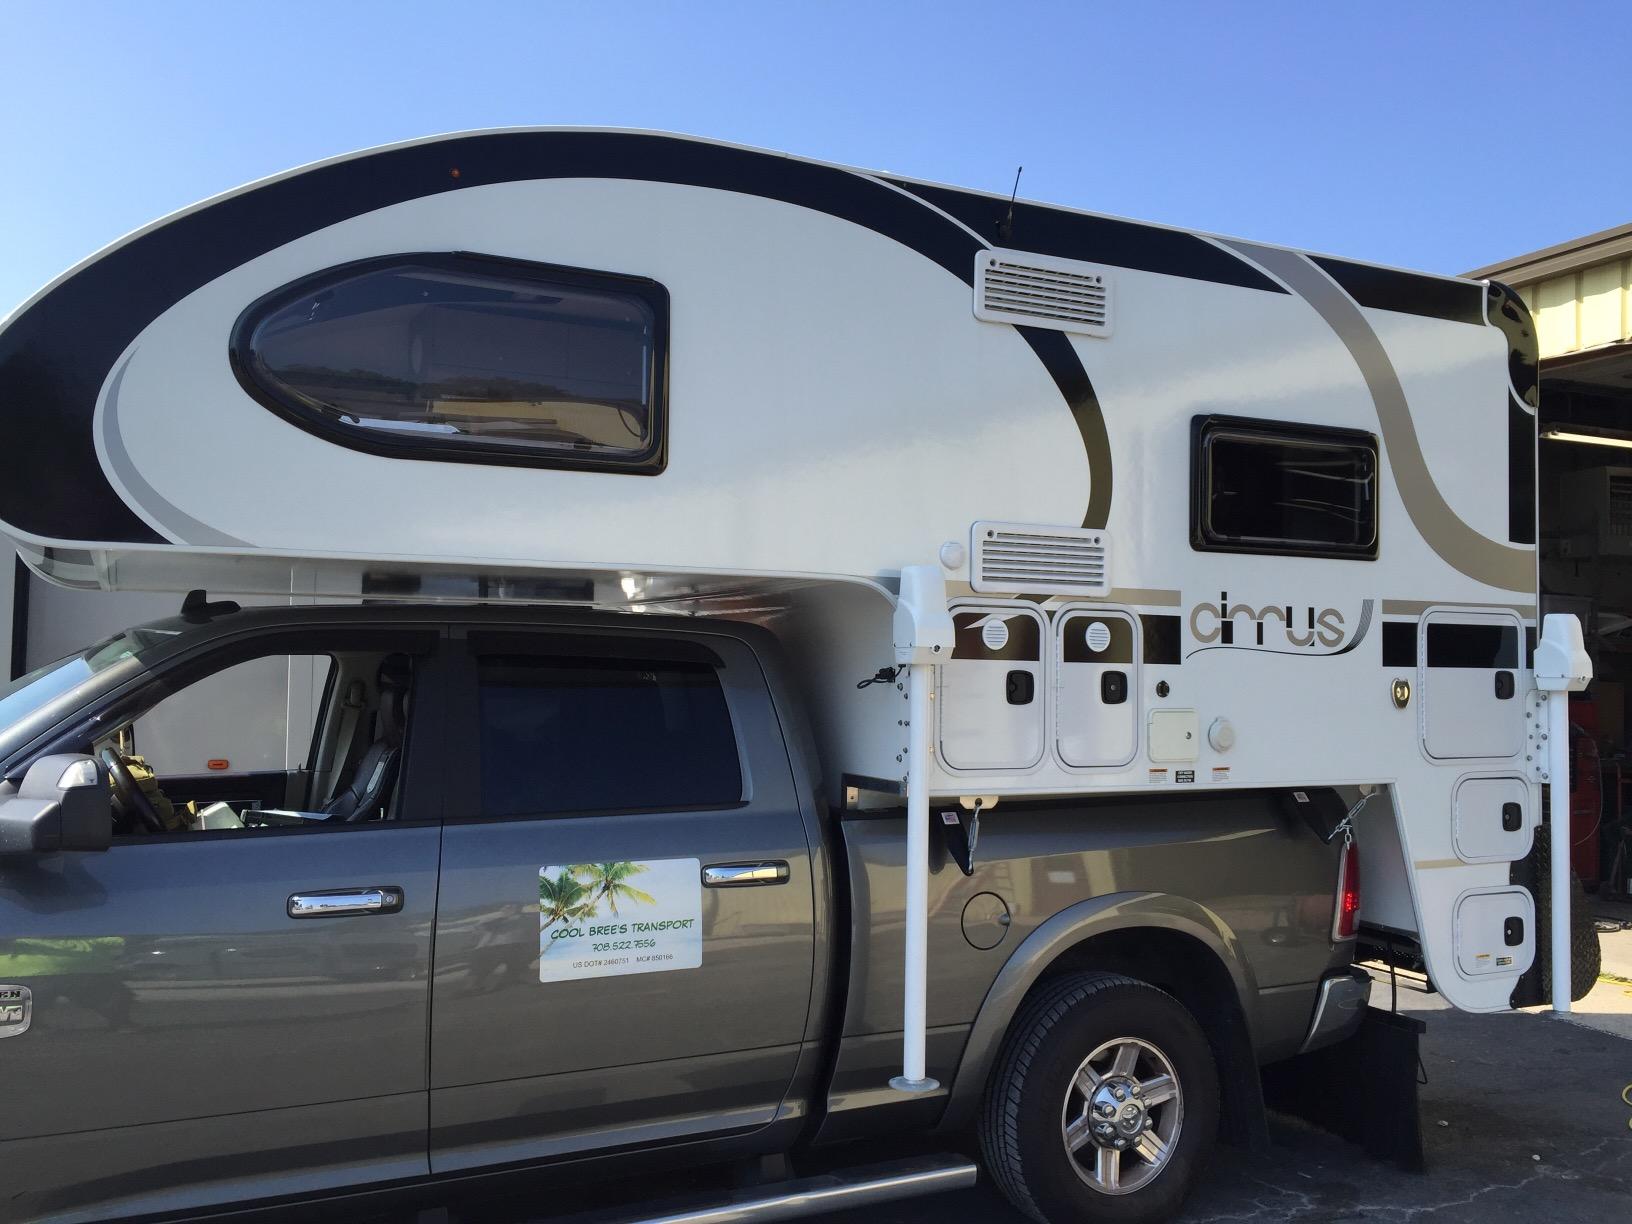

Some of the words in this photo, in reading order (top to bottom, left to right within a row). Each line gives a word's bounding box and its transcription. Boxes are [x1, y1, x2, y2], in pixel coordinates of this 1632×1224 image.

[1190, 591, 1345, 648] cirrus
[550, 927, 585, 940] COOL
[589, 923, 628, 937] BREE'S
[631, 918, 695, 933] TRANSPORT
[572, 961, 583, 969] US
[584, 960, 602, 968] DOT#
[636, 955, 651, 963] MC#
